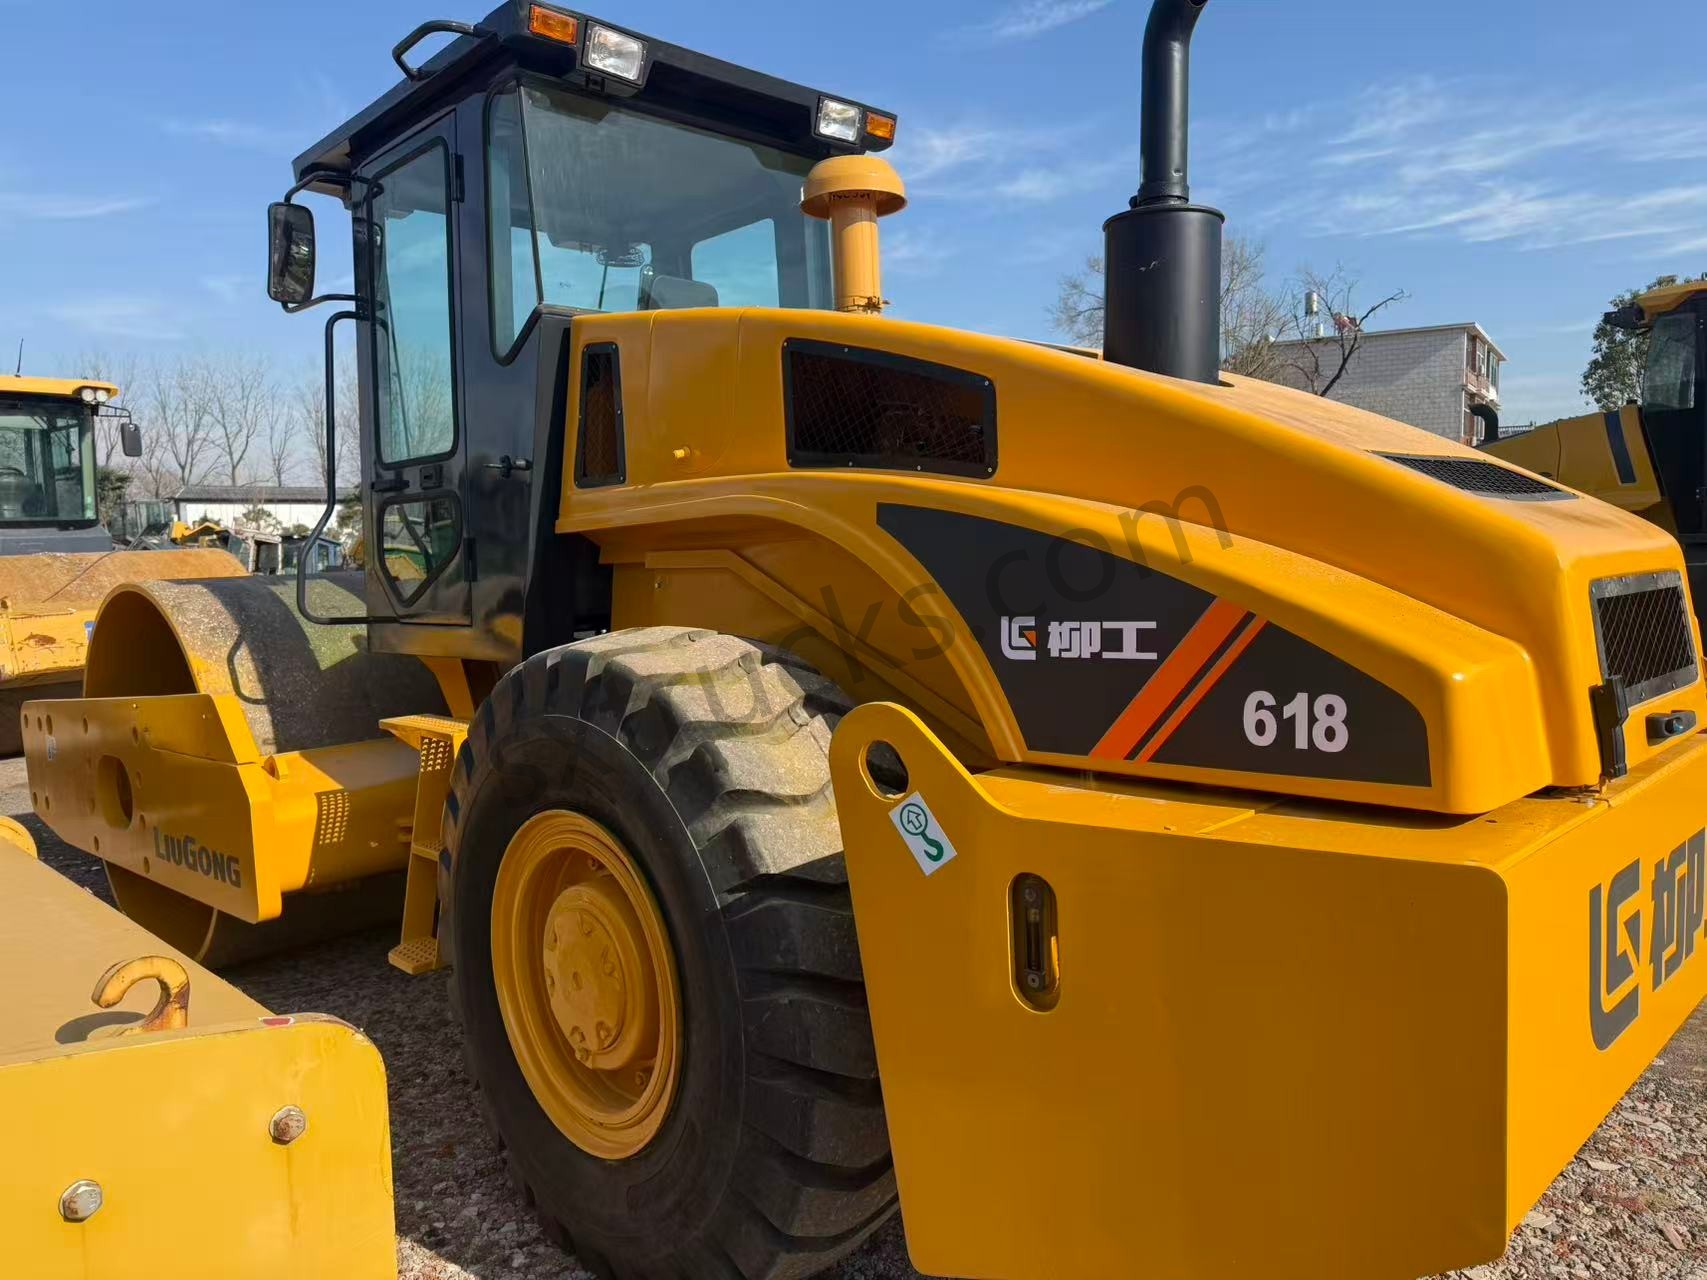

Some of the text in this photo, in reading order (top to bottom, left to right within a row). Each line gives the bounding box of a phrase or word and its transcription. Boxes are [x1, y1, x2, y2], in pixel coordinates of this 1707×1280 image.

[1047, 621, 1158, 660] 柳工
[1242, 690, 1349, 753] 618
[1648, 826, 1707, 993] 柳
